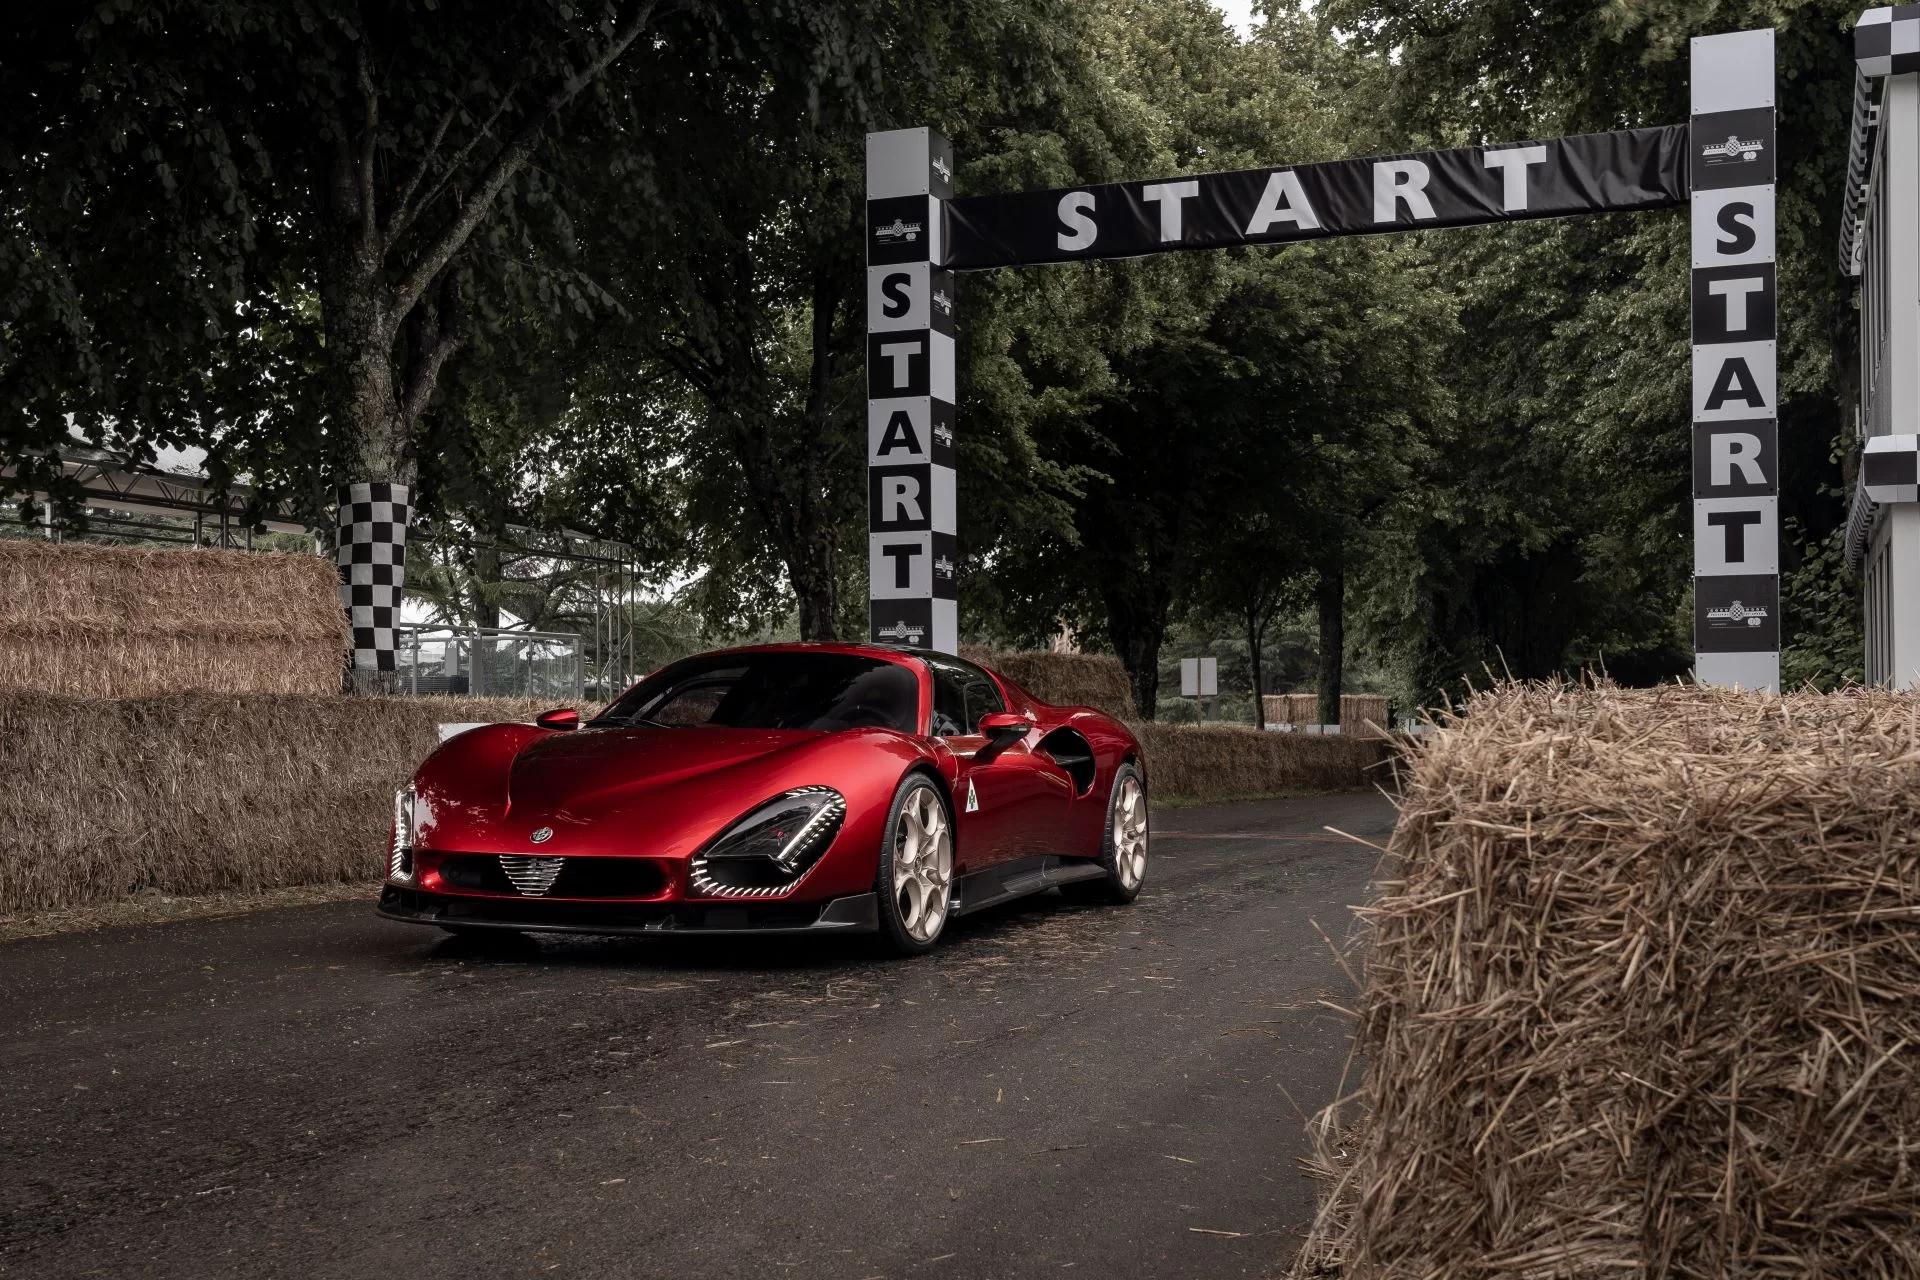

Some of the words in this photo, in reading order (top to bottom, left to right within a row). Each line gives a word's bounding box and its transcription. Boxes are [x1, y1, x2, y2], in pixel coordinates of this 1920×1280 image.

[1057, 145, 1547, 251] START
[876, 272, 925, 589] START
[1704, 201, 1768, 563] START
